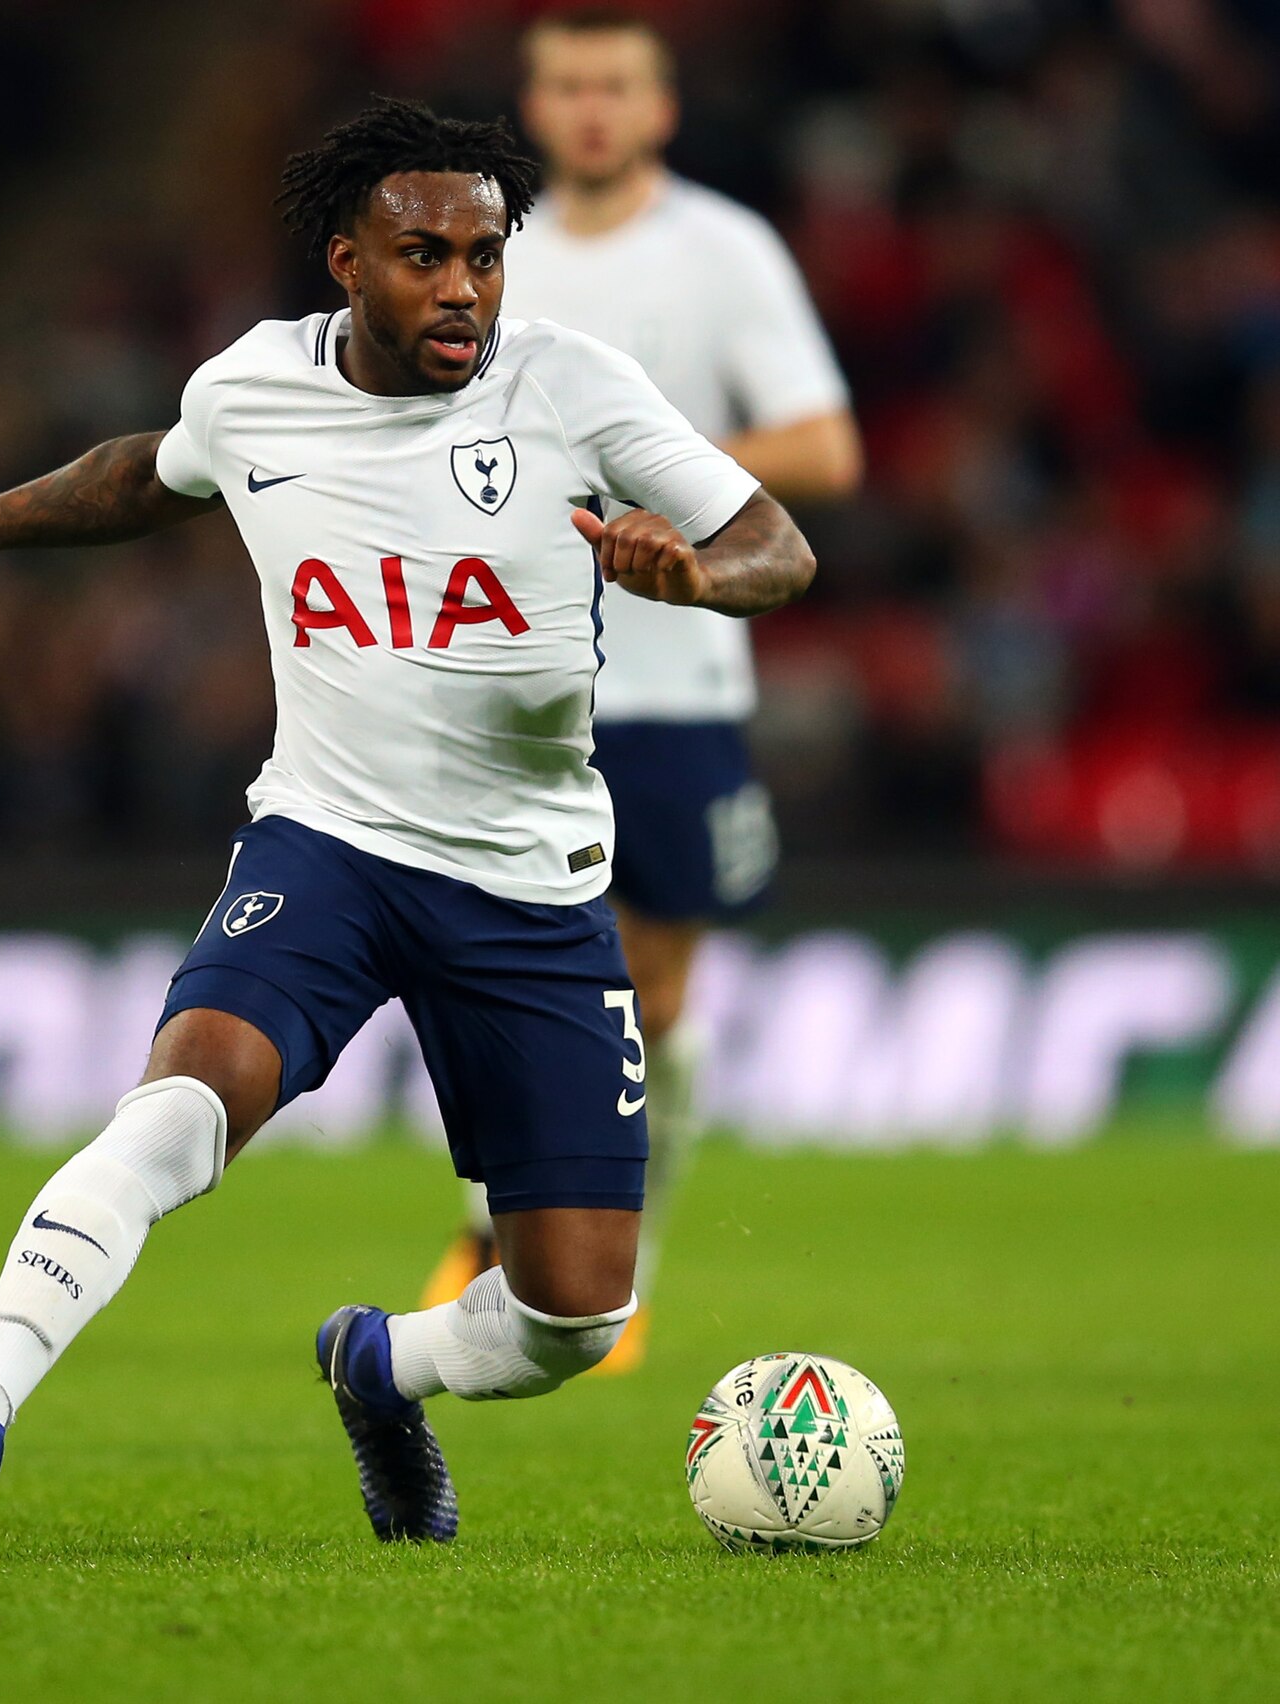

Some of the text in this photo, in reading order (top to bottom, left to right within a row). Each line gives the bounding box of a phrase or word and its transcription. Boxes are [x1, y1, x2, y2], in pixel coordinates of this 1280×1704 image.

[291, 555, 531, 649] AIA
[603, 989, 646, 1084] 3
[18, 1249, 83, 1300] SPURS
